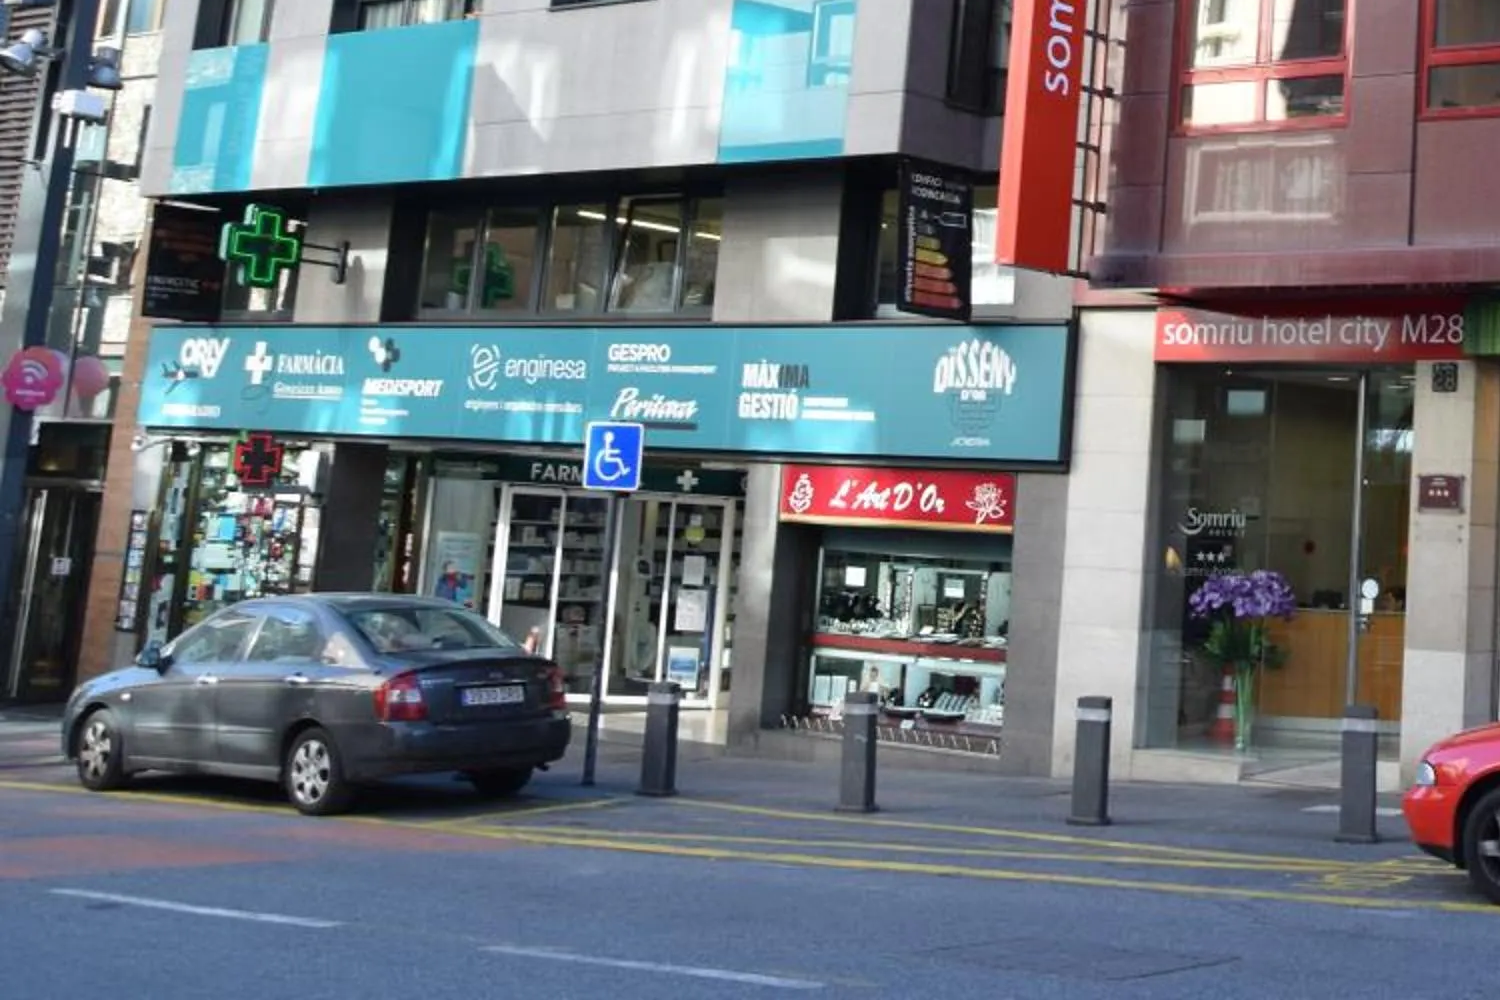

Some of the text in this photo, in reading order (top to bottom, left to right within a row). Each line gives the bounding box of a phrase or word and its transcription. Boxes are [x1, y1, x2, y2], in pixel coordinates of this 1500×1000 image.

[1163, 314, 1464, 352] somriu hotel city M28
[608, 343, 671, 362] GESPRO
[505, 354, 587, 384] enginesa
[361, 378, 444, 397] MEDISPORT
[738, 388, 799, 420] GESTIÓ
[1178, 507, 1247, 535] Somriu
